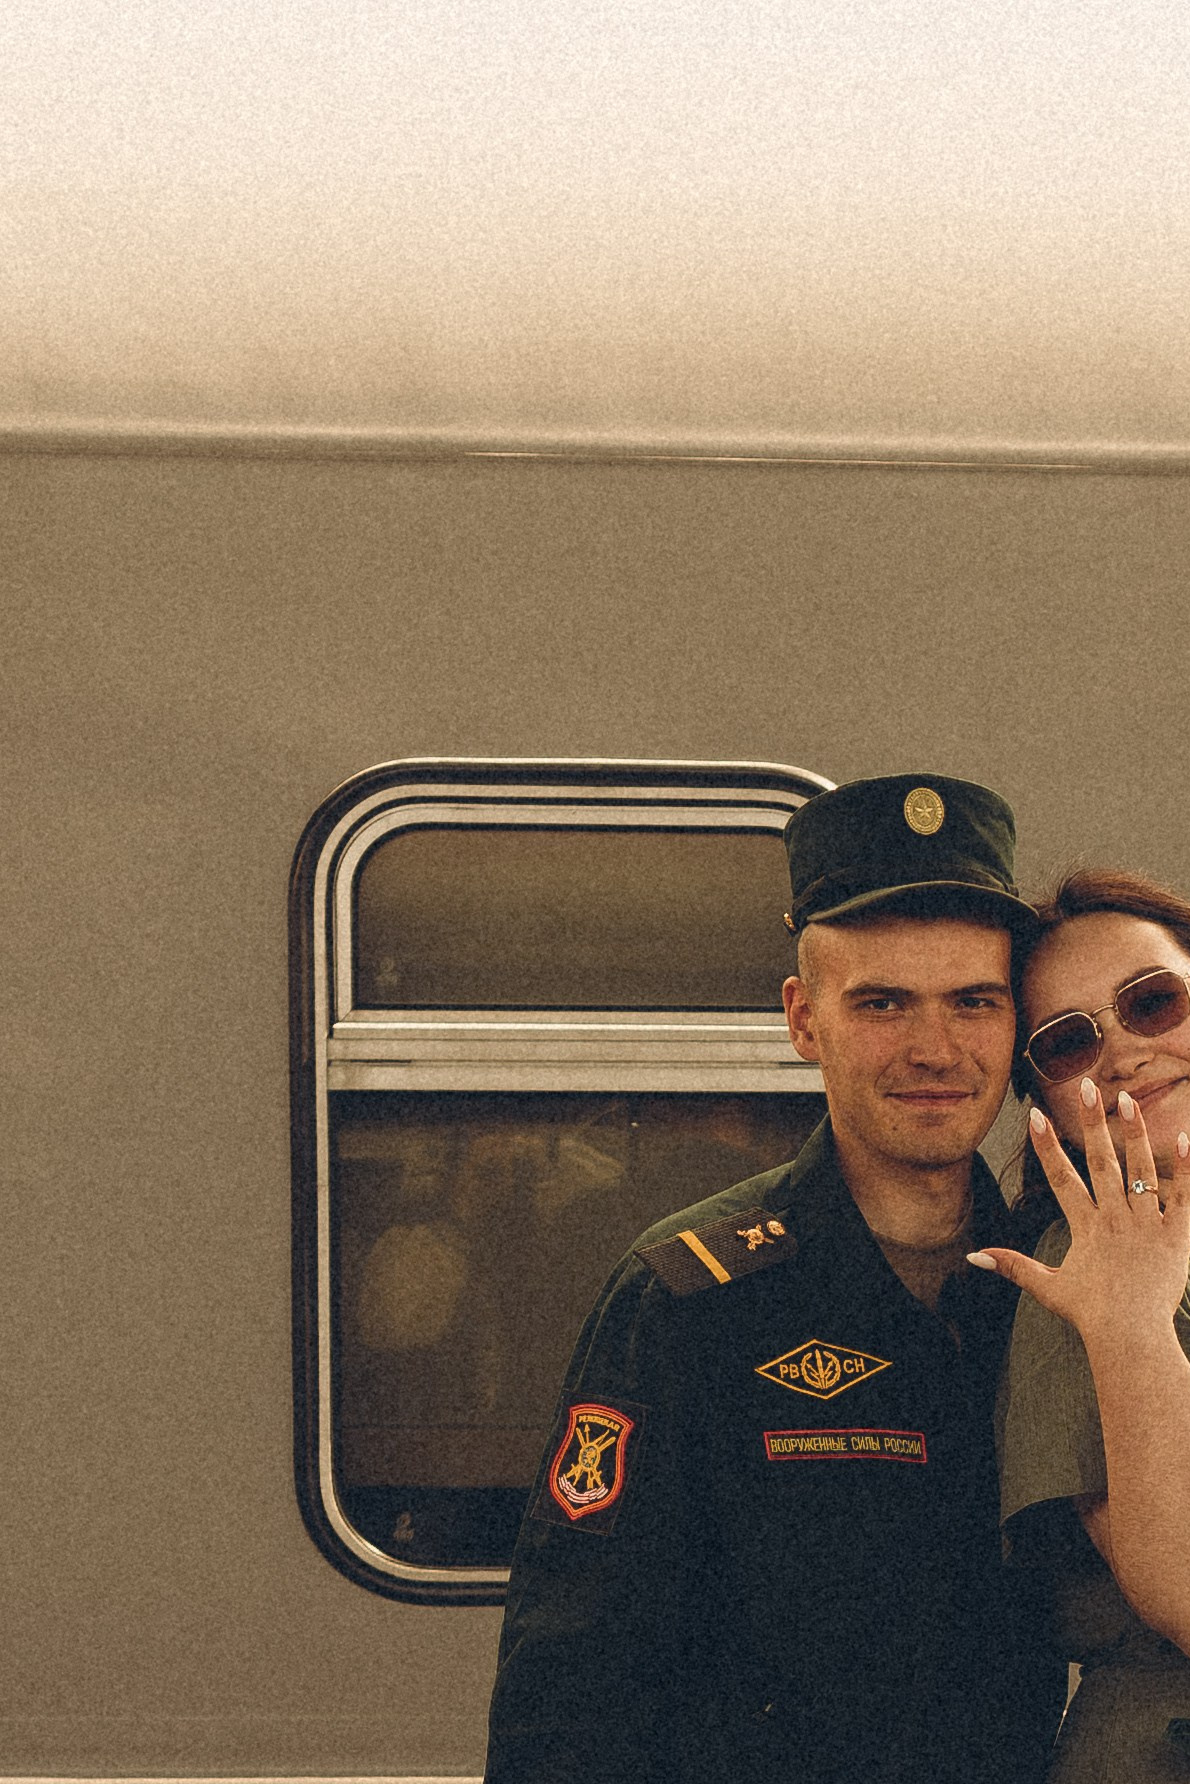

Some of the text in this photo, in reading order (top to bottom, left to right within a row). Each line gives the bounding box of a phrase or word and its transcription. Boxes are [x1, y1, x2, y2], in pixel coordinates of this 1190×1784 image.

[779, 1357, 866, 1379] РВ СН
[769, 1436, 922, 1455] ВООРУЖЕННЫЕ СИЛЫ РОССИИ
